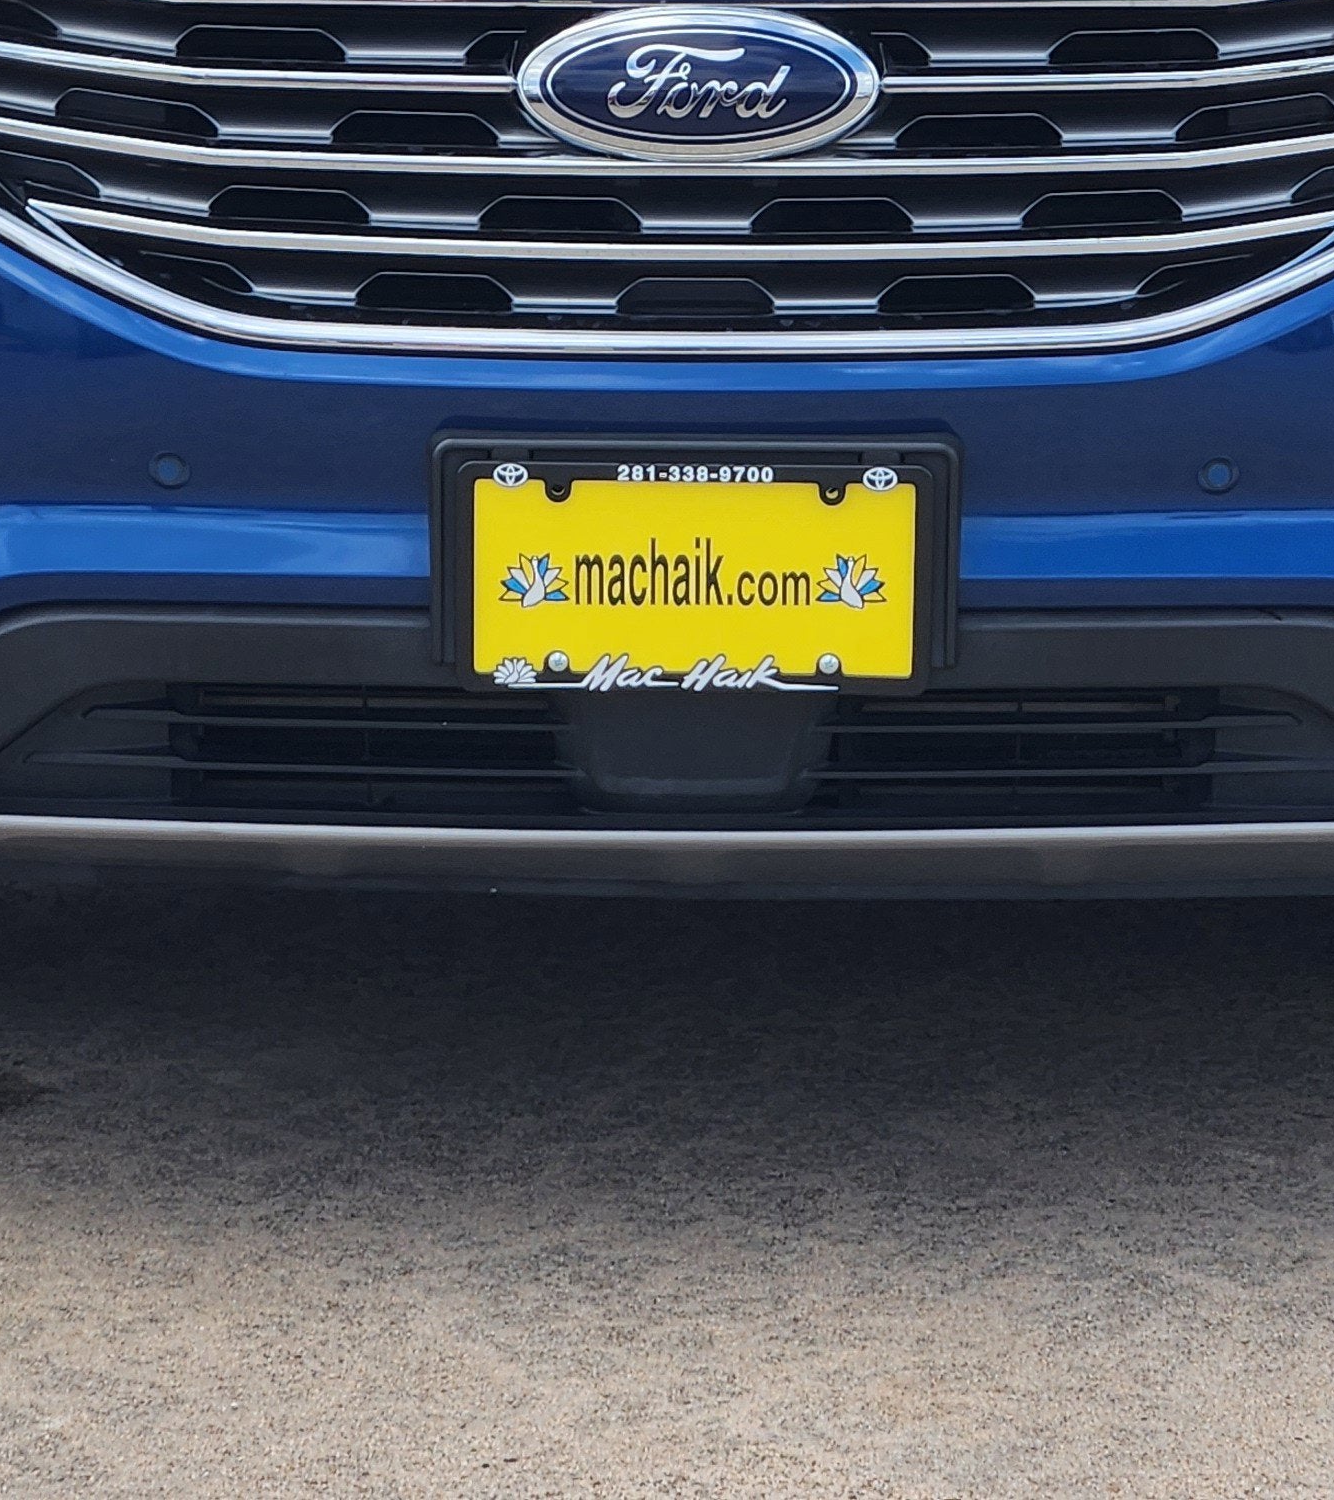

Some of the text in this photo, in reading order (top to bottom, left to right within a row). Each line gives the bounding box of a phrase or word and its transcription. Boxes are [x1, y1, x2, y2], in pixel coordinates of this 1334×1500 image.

[607, 43, 790, 119] Ford
[616, 464, 774, 483] 281-338-9700
[574, 537, 811, 607] machaik.com
[581, 653, 784, 693] Mac Haik
